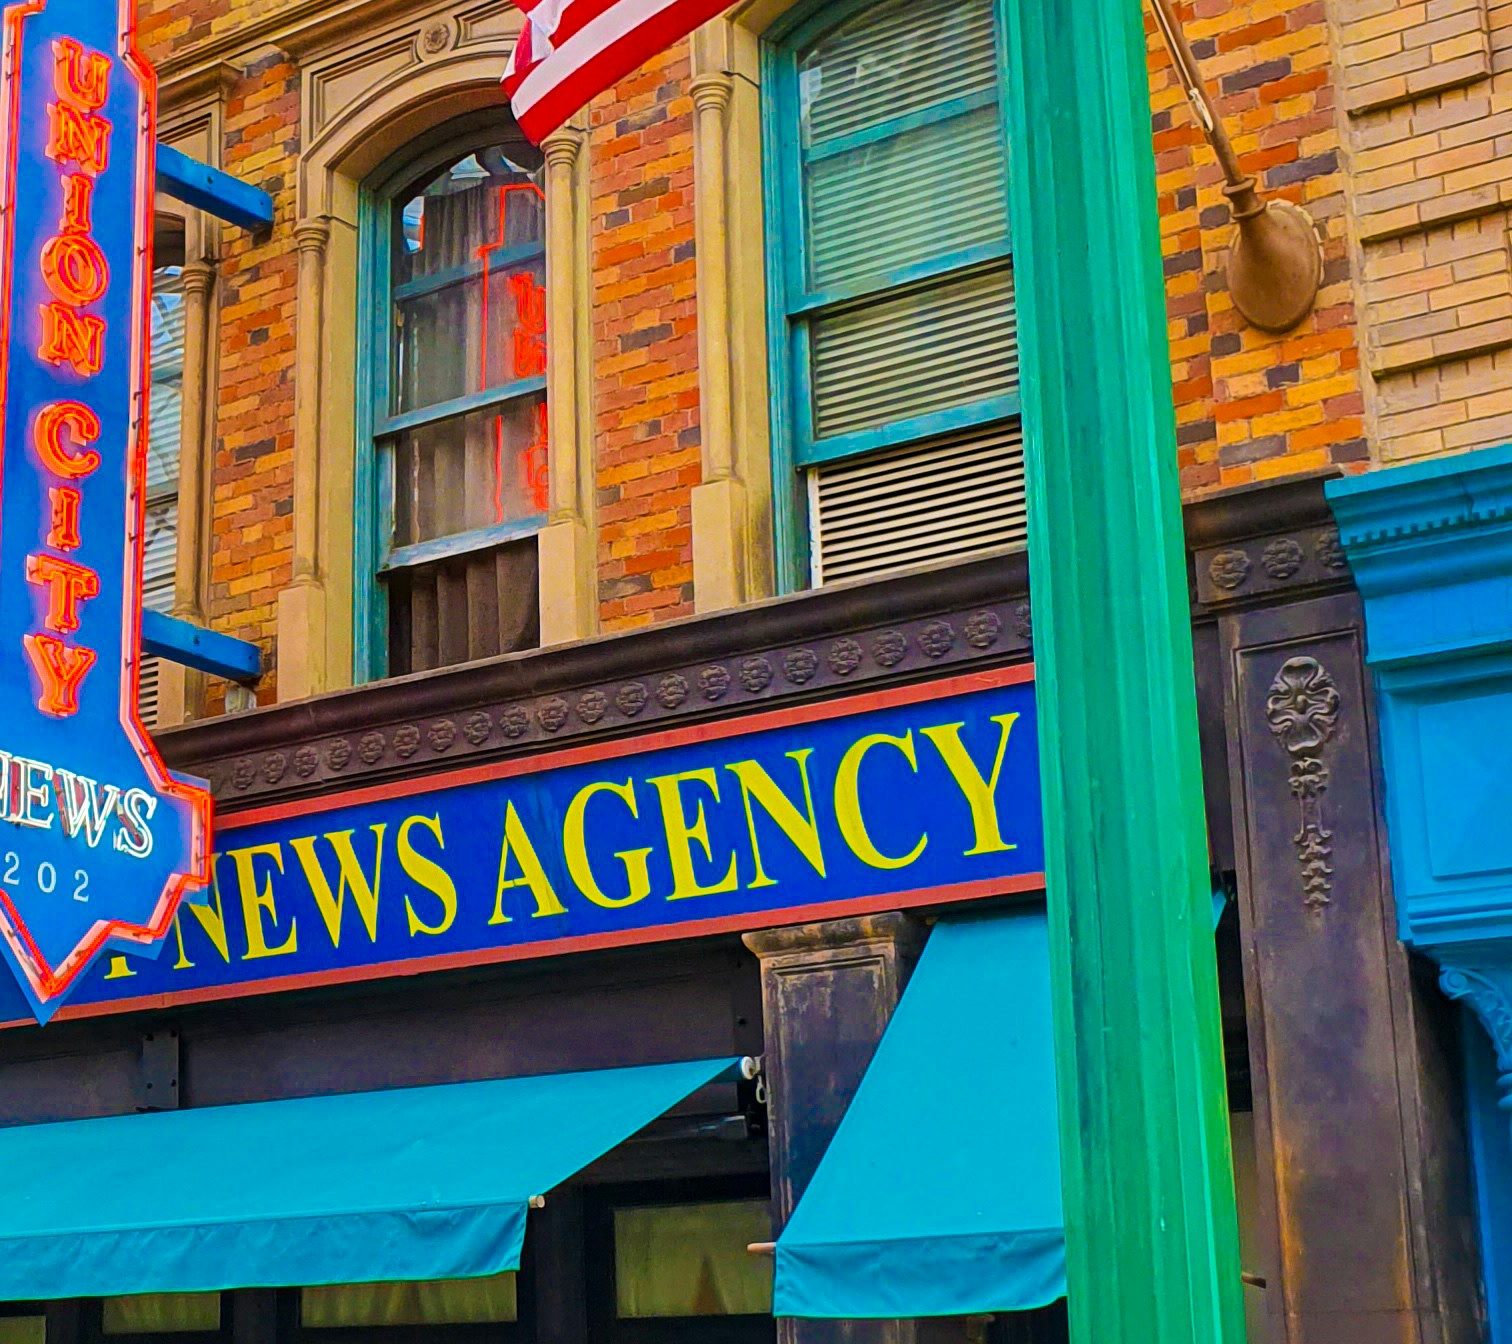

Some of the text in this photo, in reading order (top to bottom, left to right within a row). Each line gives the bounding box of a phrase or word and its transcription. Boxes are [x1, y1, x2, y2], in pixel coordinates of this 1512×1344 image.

[23, 37, 112, 718] UNION CITY
[173, 811, 458, 969] NEWS
[488, 711, 1021, 926] AGENCY
